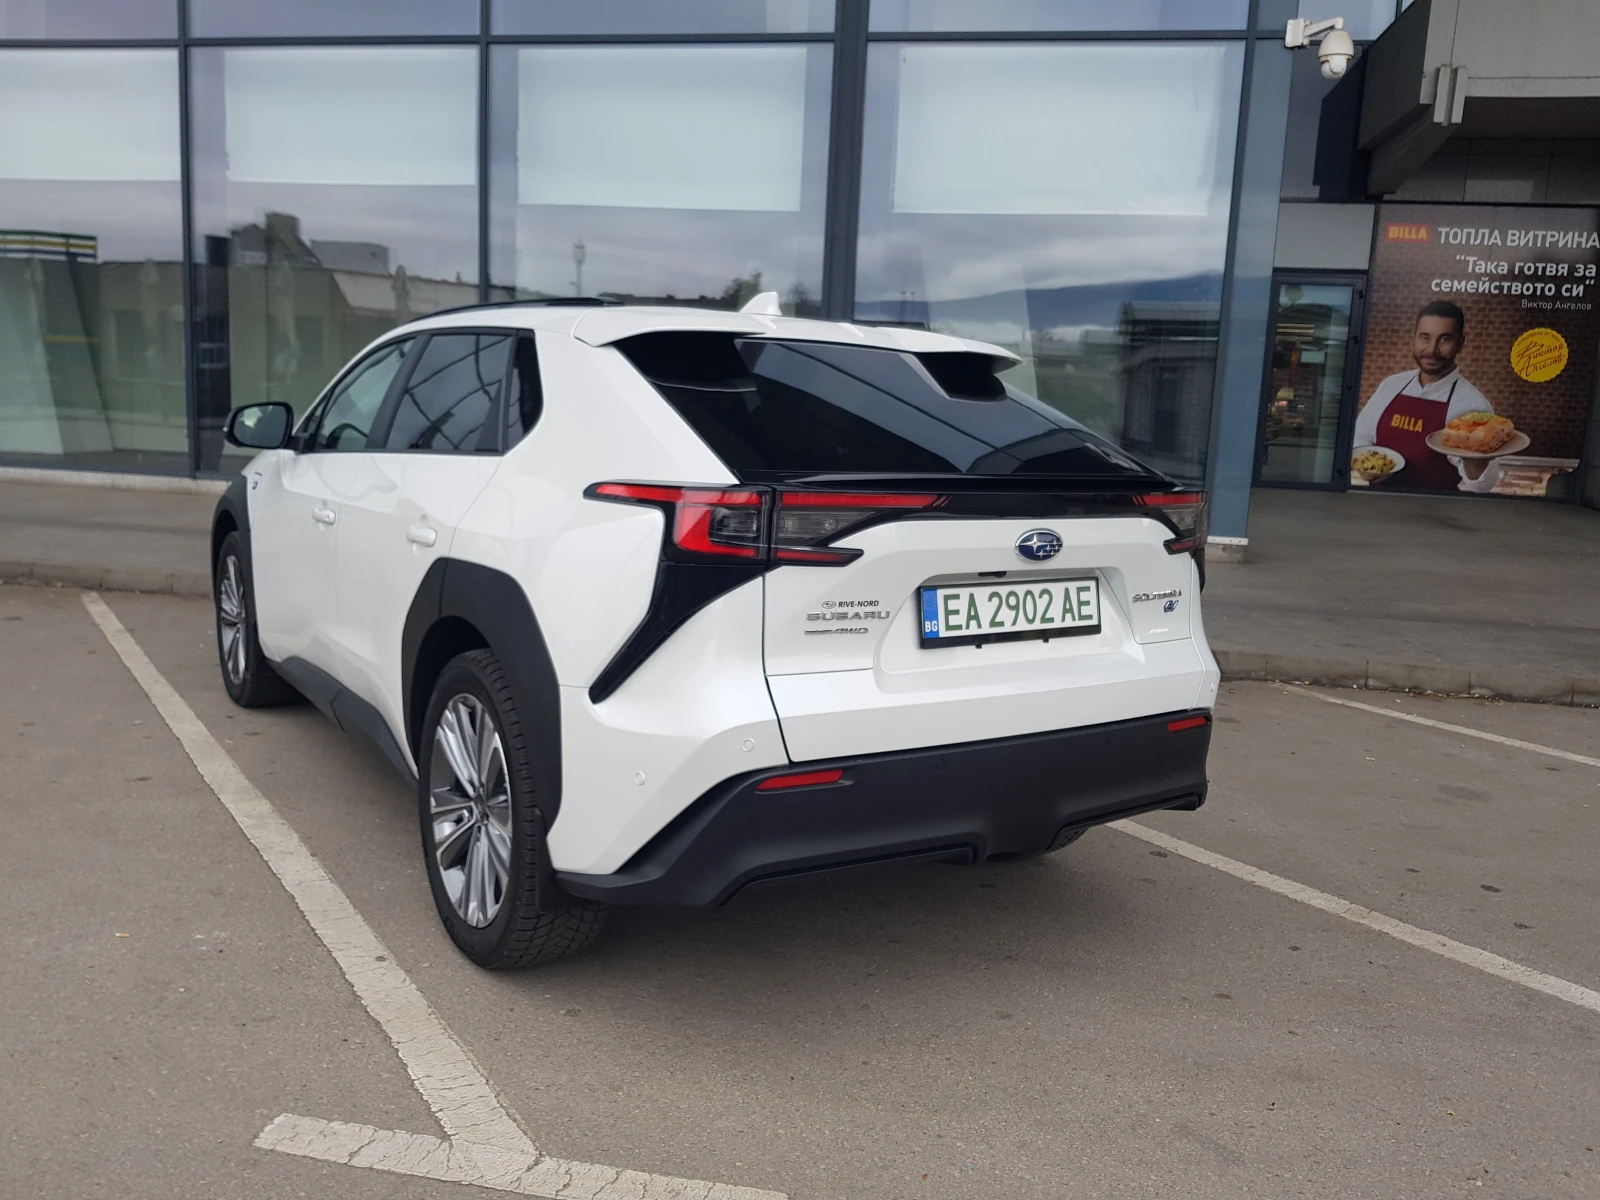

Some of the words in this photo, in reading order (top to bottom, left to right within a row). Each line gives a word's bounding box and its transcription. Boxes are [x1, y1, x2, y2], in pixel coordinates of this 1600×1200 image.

[1388, 225, 1427, 240] BILLA
[1438, 227, 1501, 247] ТОПЛА
[1506, 229, 1600, 249] ВИТРИНА
[1514, 262, 1568, 277] готвя
[1573, 263, 1597, 278] за
[1431, 277, 1556, 296] семейството
[1521, 300, 1553, 311] Виктор
[1554, 301, 1592, 311] Ангелов
[1391, 414, 1423, 433] BILLA
[838, 600, 880, 608] RIVE-NORD
[925, 621, 938, 632] BG
[943, 593, 982, 632] EA
[987, 588, 1055, 628] 2902
[1060, 585, 1094, 623] AE
[806, 611, 891, 621] SUBARU
